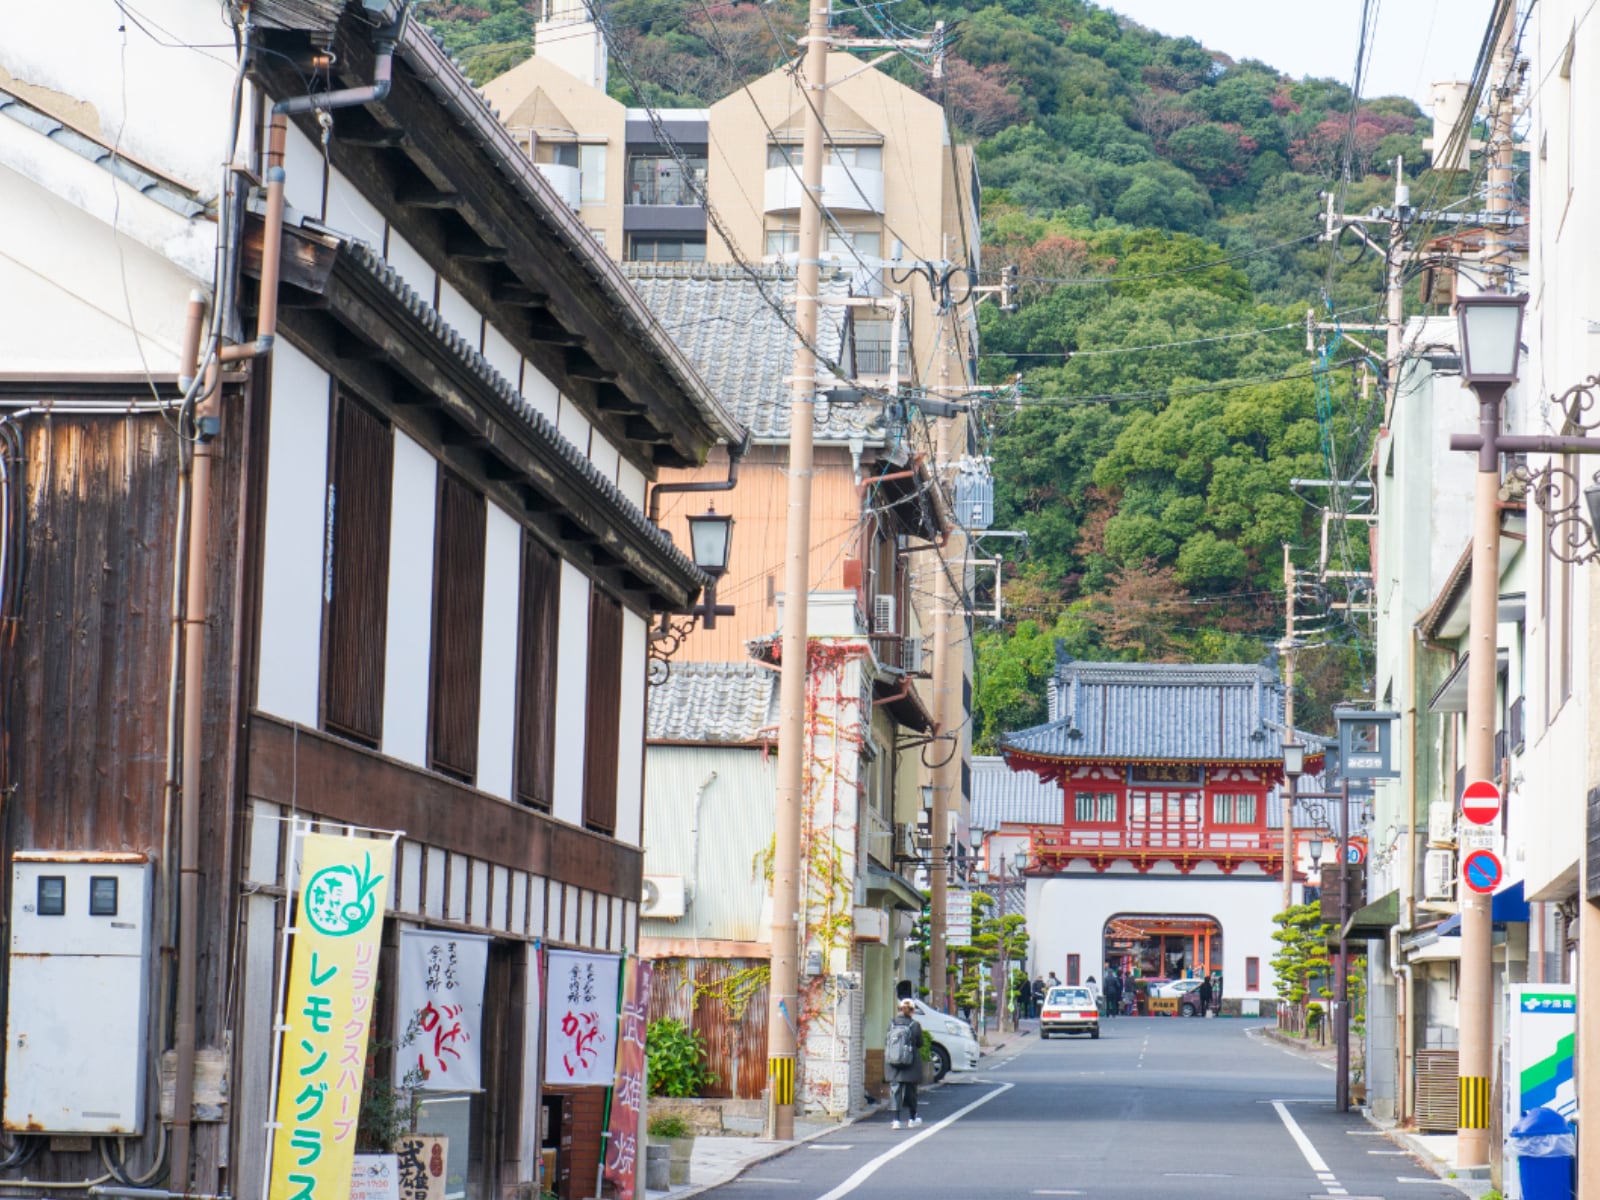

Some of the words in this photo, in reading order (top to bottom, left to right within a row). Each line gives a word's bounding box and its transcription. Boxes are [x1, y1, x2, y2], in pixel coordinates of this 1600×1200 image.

[426, 945, 442, 992] 案内所
[445, 941, 460, 990] まちなか
[288, 952, 338, 1200] レモングラス
[418, 1000, 471, 1081] がばい
[561, 1010, 606, 1077] がばい
[610, 1003, 646, 1175] 武雄焼
